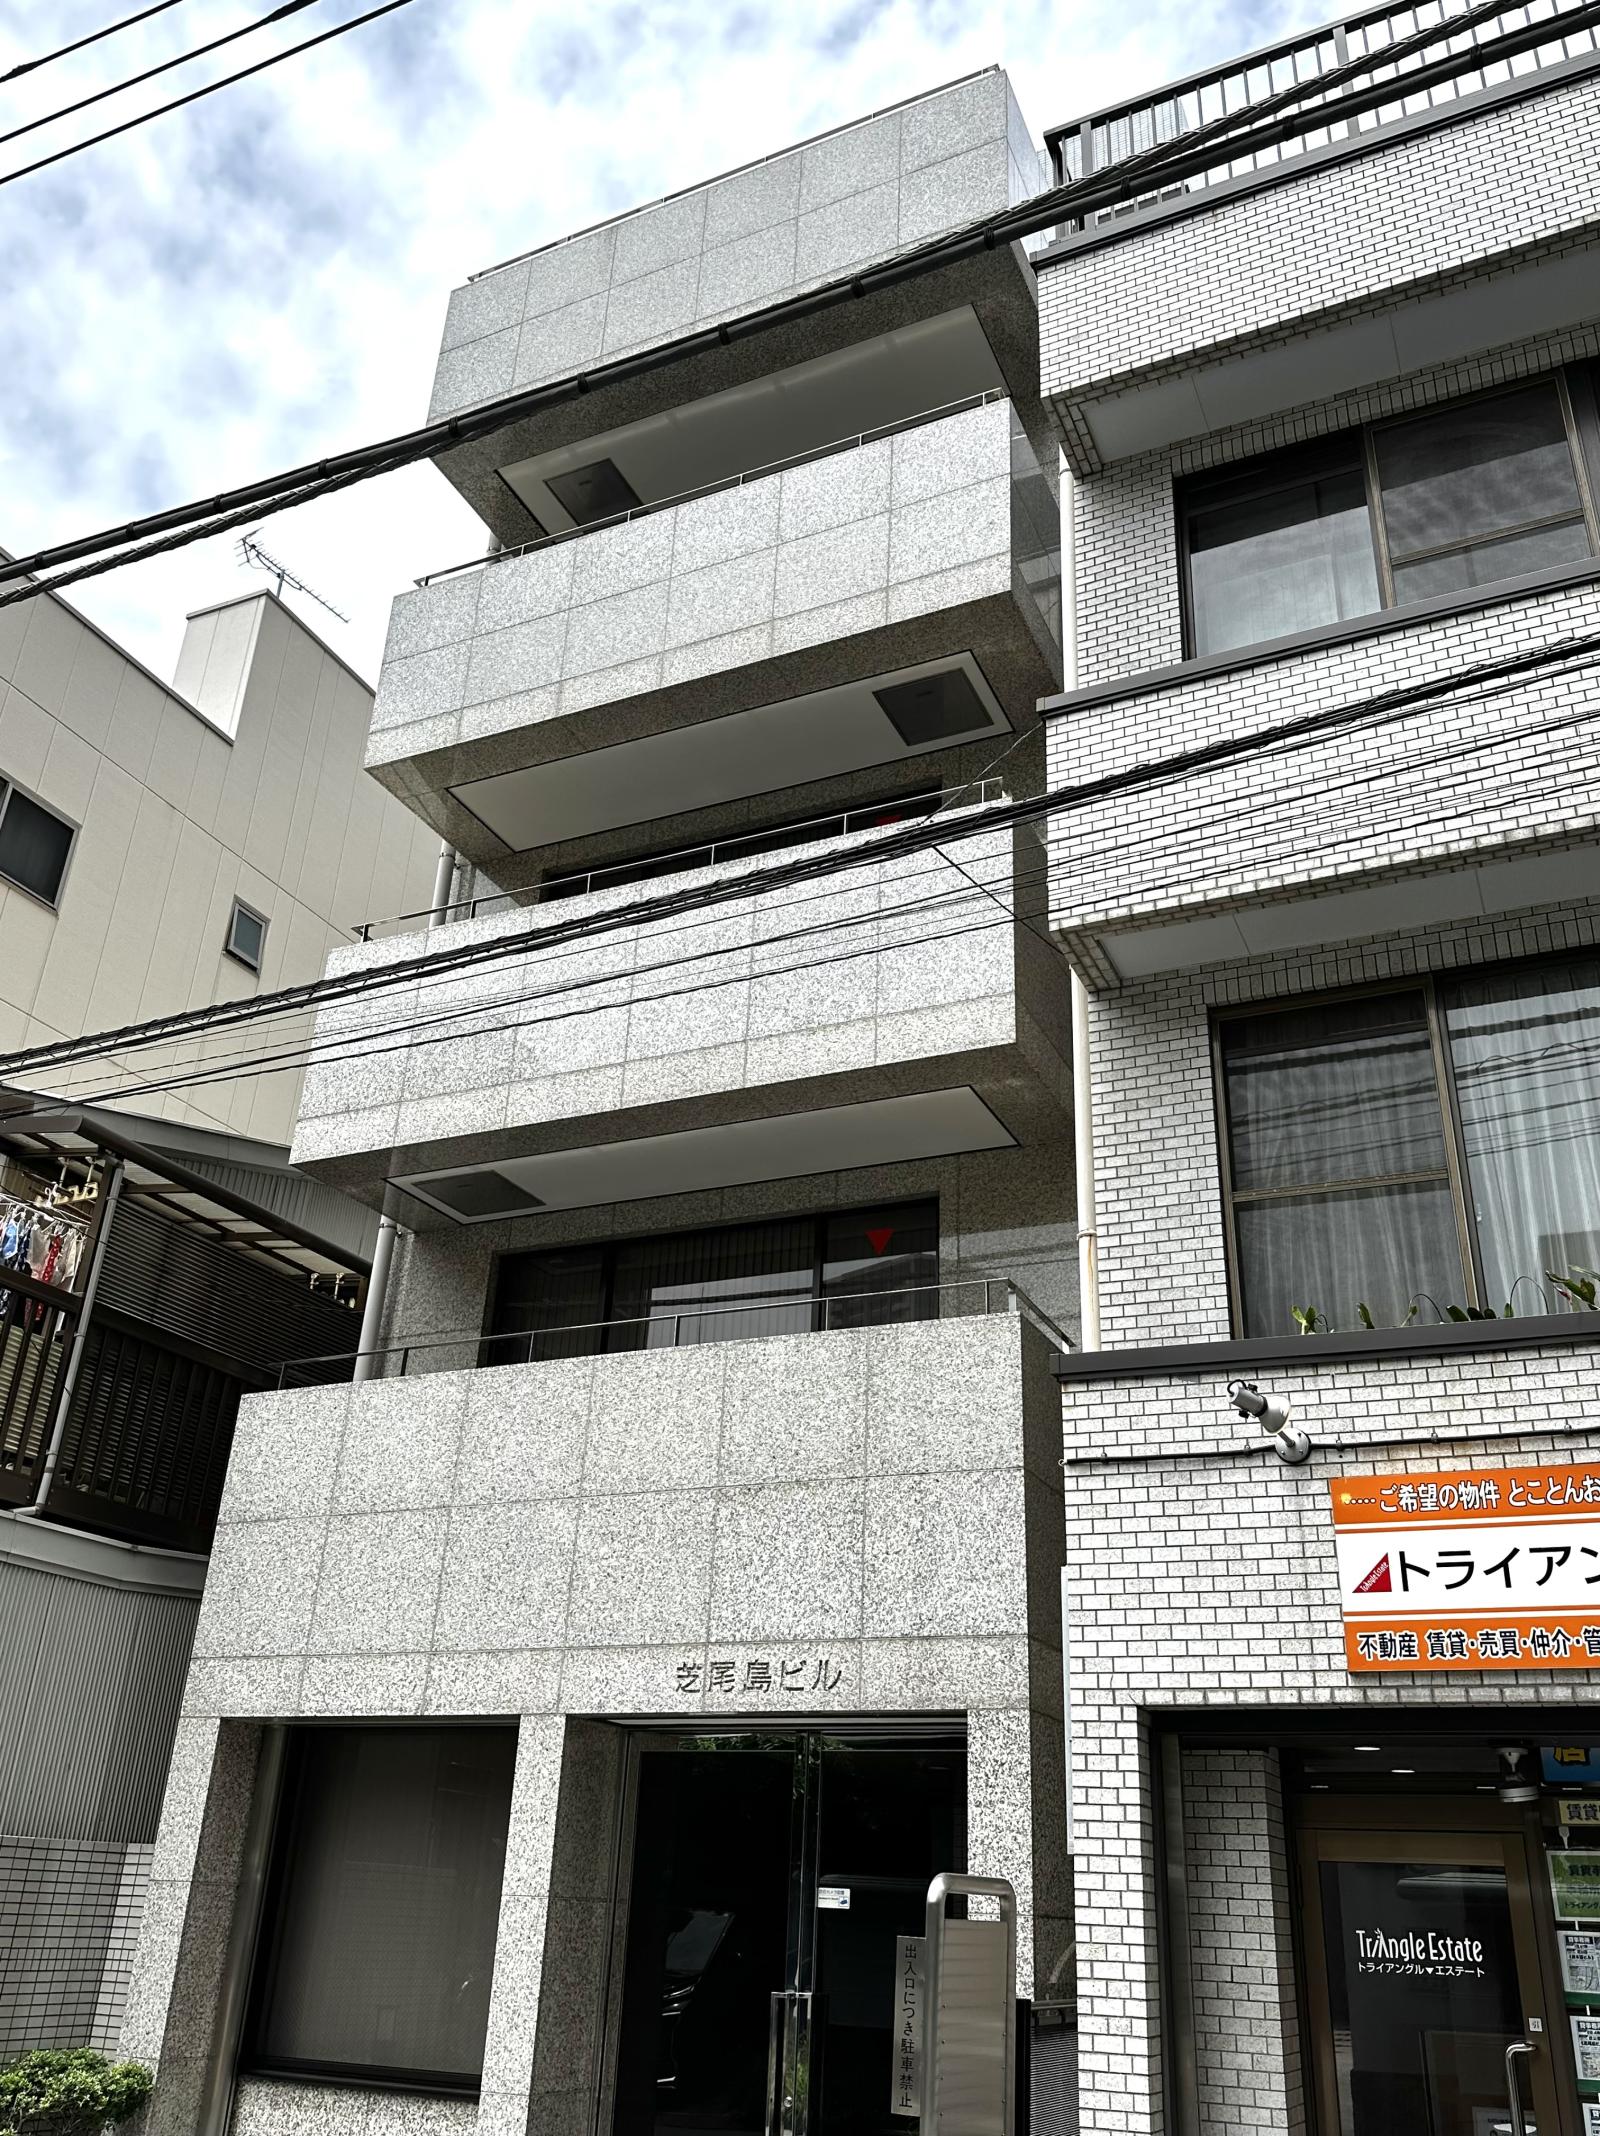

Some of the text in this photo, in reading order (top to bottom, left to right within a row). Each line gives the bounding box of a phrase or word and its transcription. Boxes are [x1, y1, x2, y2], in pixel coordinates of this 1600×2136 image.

[1380, 1479, 1500, 1513] ご希望の物件
[1357, 1630, 1418, 1660] 不動産
[675, 1659, 842, 1693] 芝尾島ビル
[1567, 1803, 1600, 1821] 賃貸
[1564, 1901, 1600, 1910] トライアング
[1428, 1932, 1483, 1962] Estate
[899, 1943, 917, 2109] 出入口につき駐車禁止
